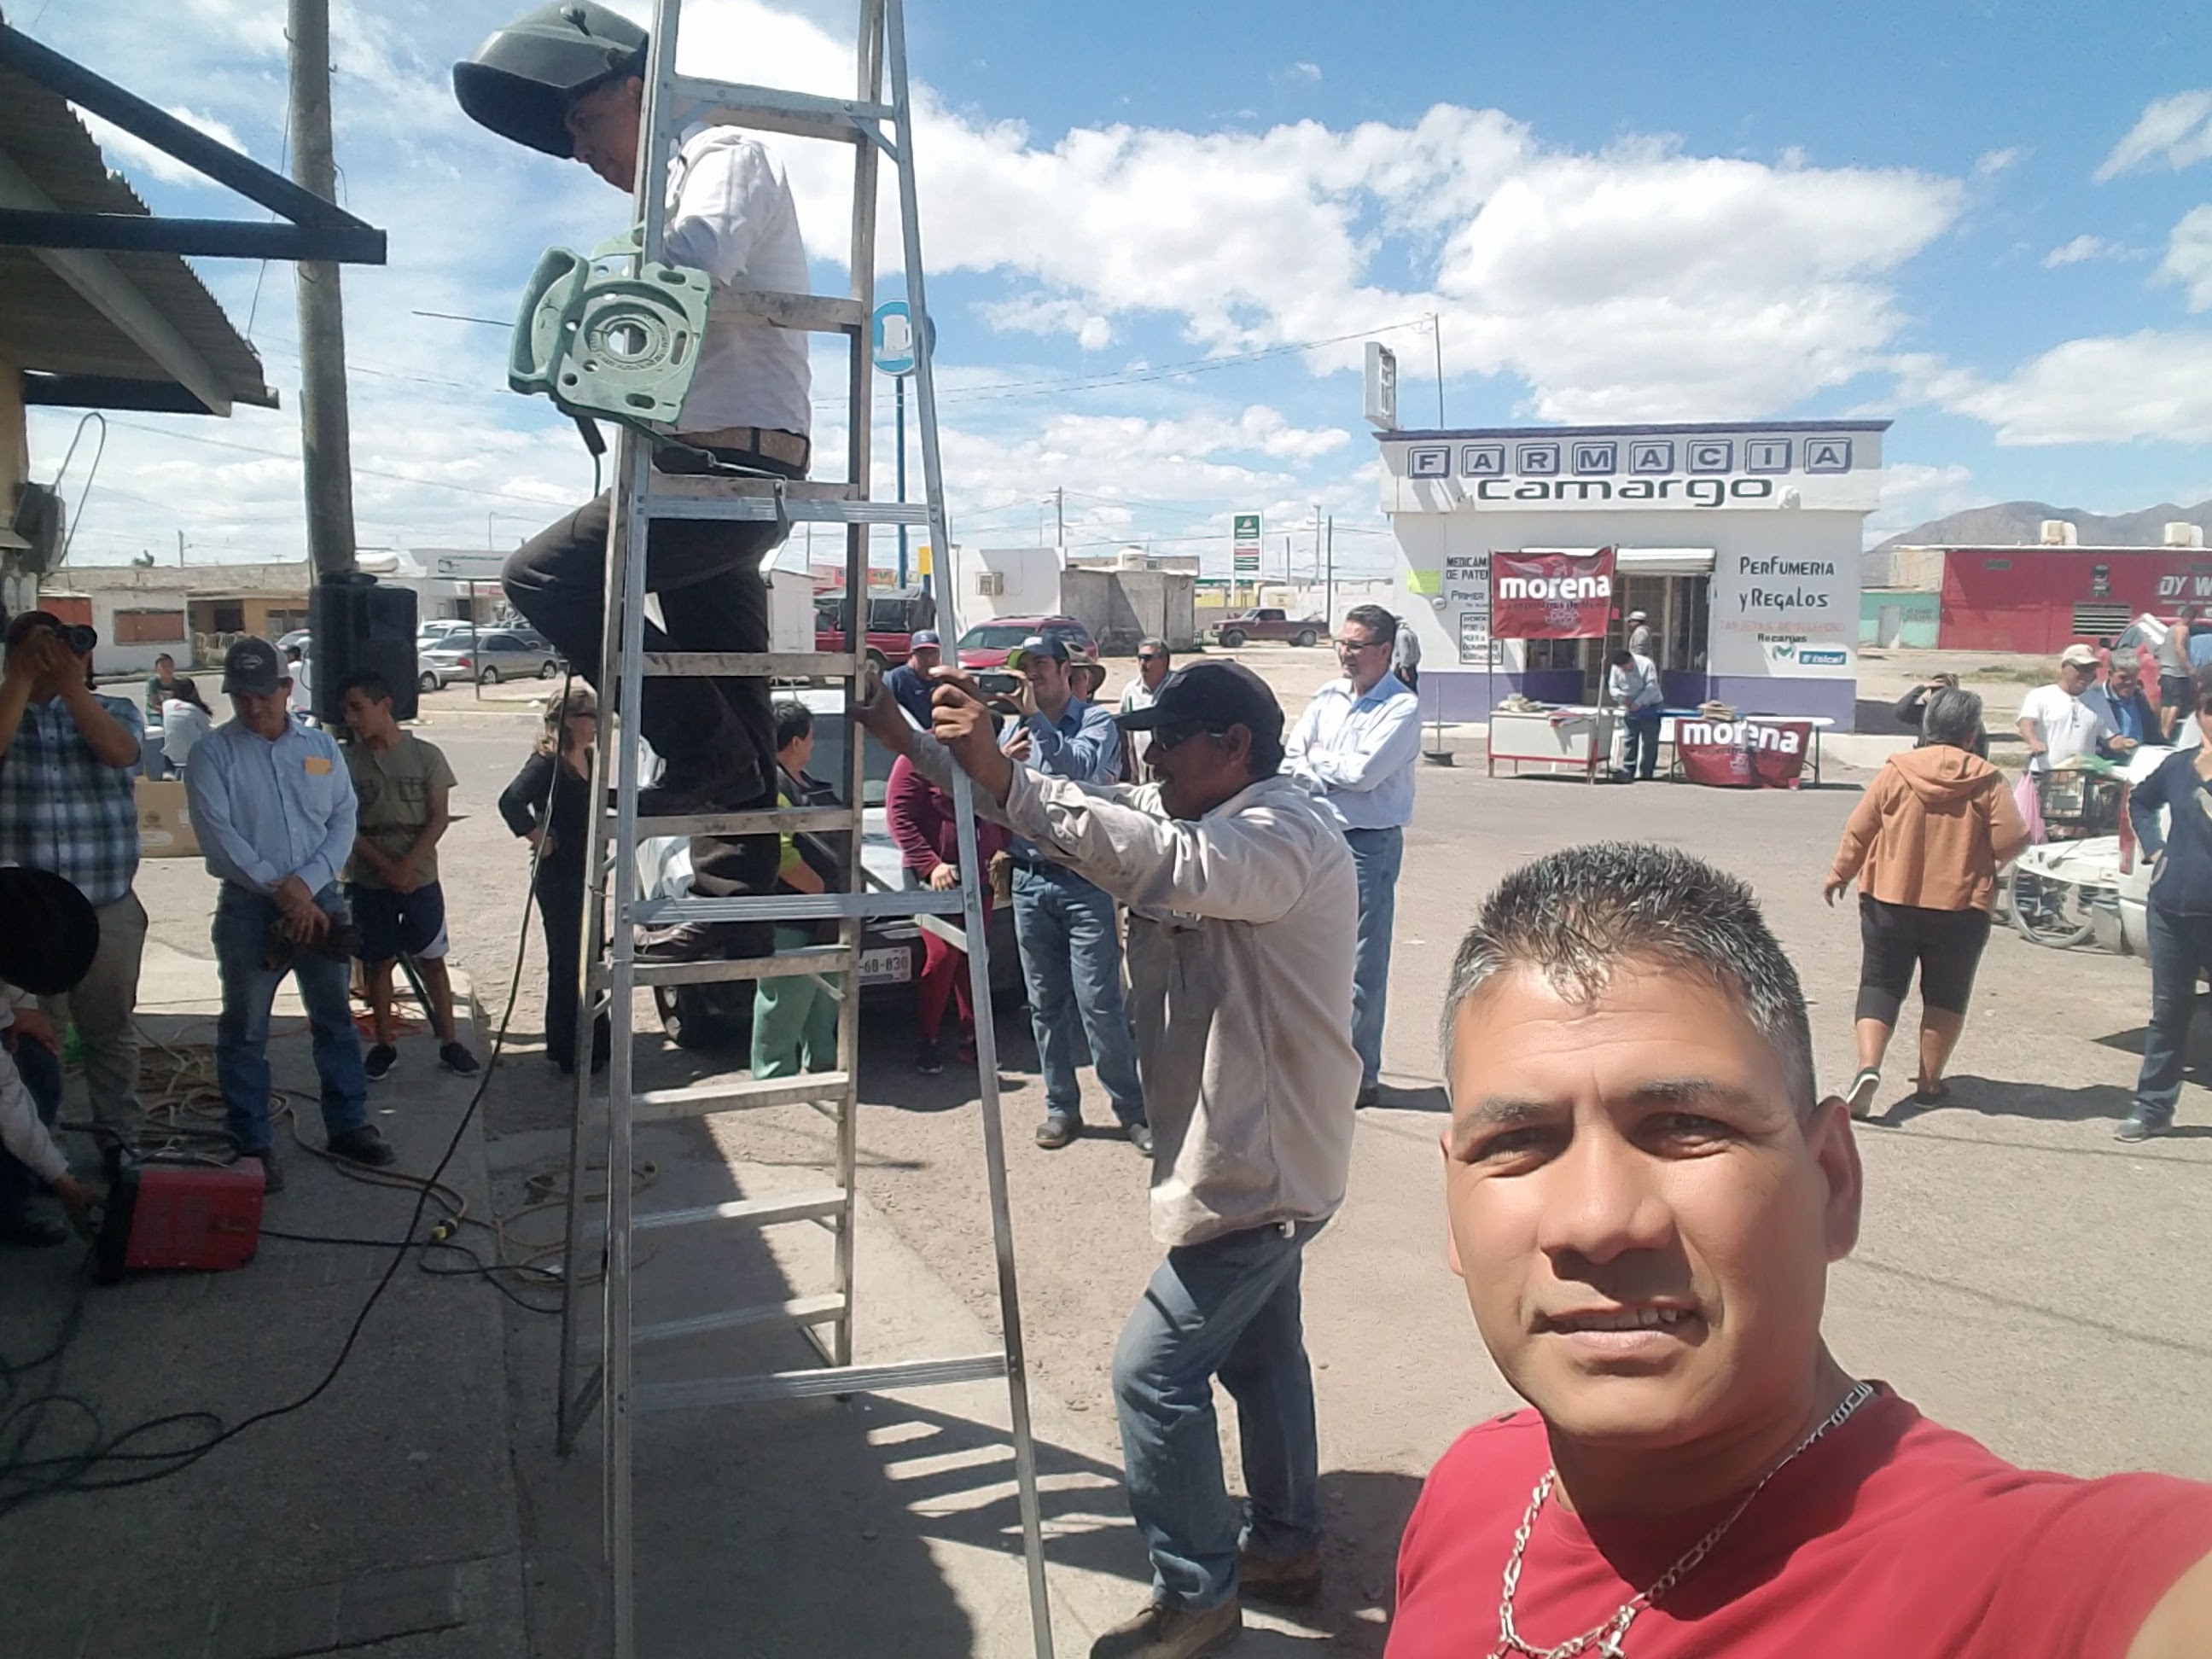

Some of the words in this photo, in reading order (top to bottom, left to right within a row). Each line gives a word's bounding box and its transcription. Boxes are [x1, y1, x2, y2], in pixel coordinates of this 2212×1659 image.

[1417, 446, 1841, 471] FARMACIA
[1477, 478, 1773, 508] camargo
[1446, 569, 1459, 580] DE
[1739, 556, 1835, 576] PERFUMERIA
[1499, 574, 1610, 600] morena
[1682, 720, 1800, 754] morena
